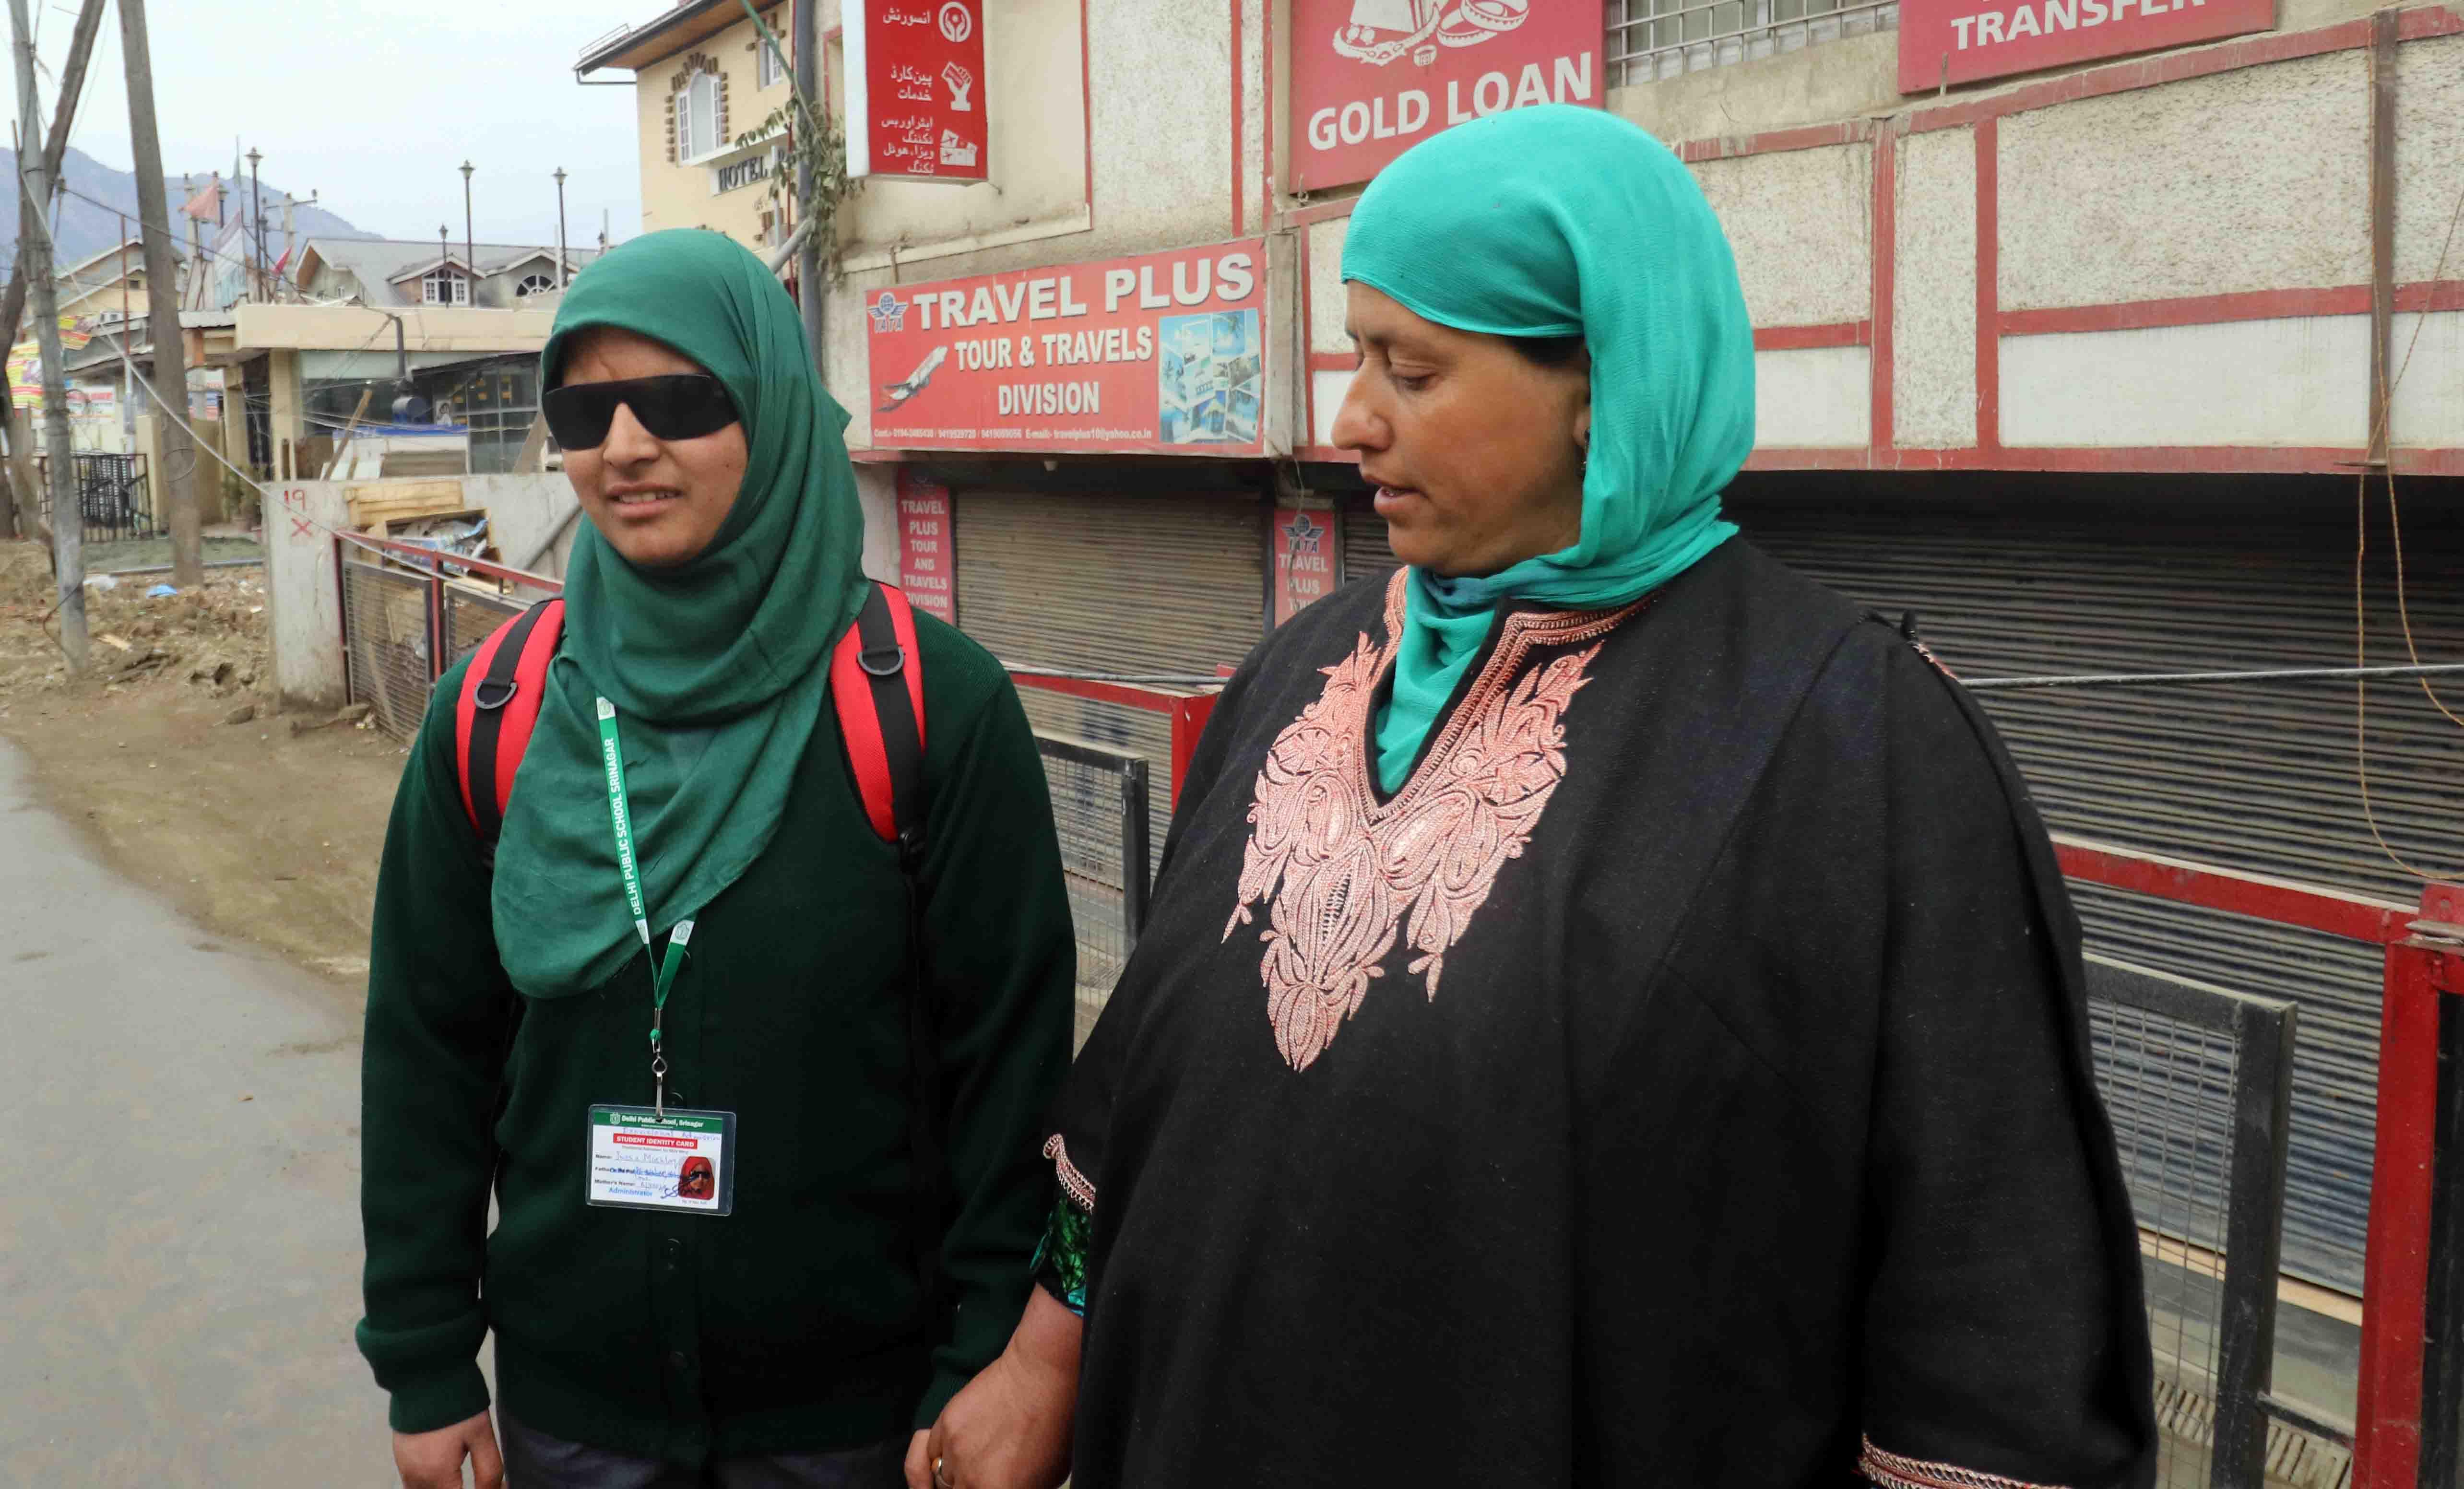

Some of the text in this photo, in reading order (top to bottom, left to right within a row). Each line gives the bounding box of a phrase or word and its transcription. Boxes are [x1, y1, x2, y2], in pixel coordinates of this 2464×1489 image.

[1951, 0, 2205, 50] TRANSF
[1308, 52, 1591, 151] GOLD LOAN
[719, 155, 768, 192] HOTEL
[913, 253, 1255, 331] TRAVEL PLUS
[955, 325, 1153, 371] TOUR & TRAVELS
[998, 382, 1101, 416] DIVISION
[901, 500, 945, 514] TRAVEL
[910, 521, 938, 535] PLUS
[911, 540, 937, 553] TOUR
[914, 558, 935, 570] AND
[1279, 553, 1328, 572] TRAVEL
[904, 575, 947, 591] TRAVELS
[1287, 578, 1320, 595] PLUS
[604, 737, 641, 915] DELHI PUBLIC SCHOOL SRINAGAR
[679, 1120, 703, 1128] Srinagar
[647, 1137, 675, 1146] IDENTITY
[608, 1186, 653, 1197] Administrator
